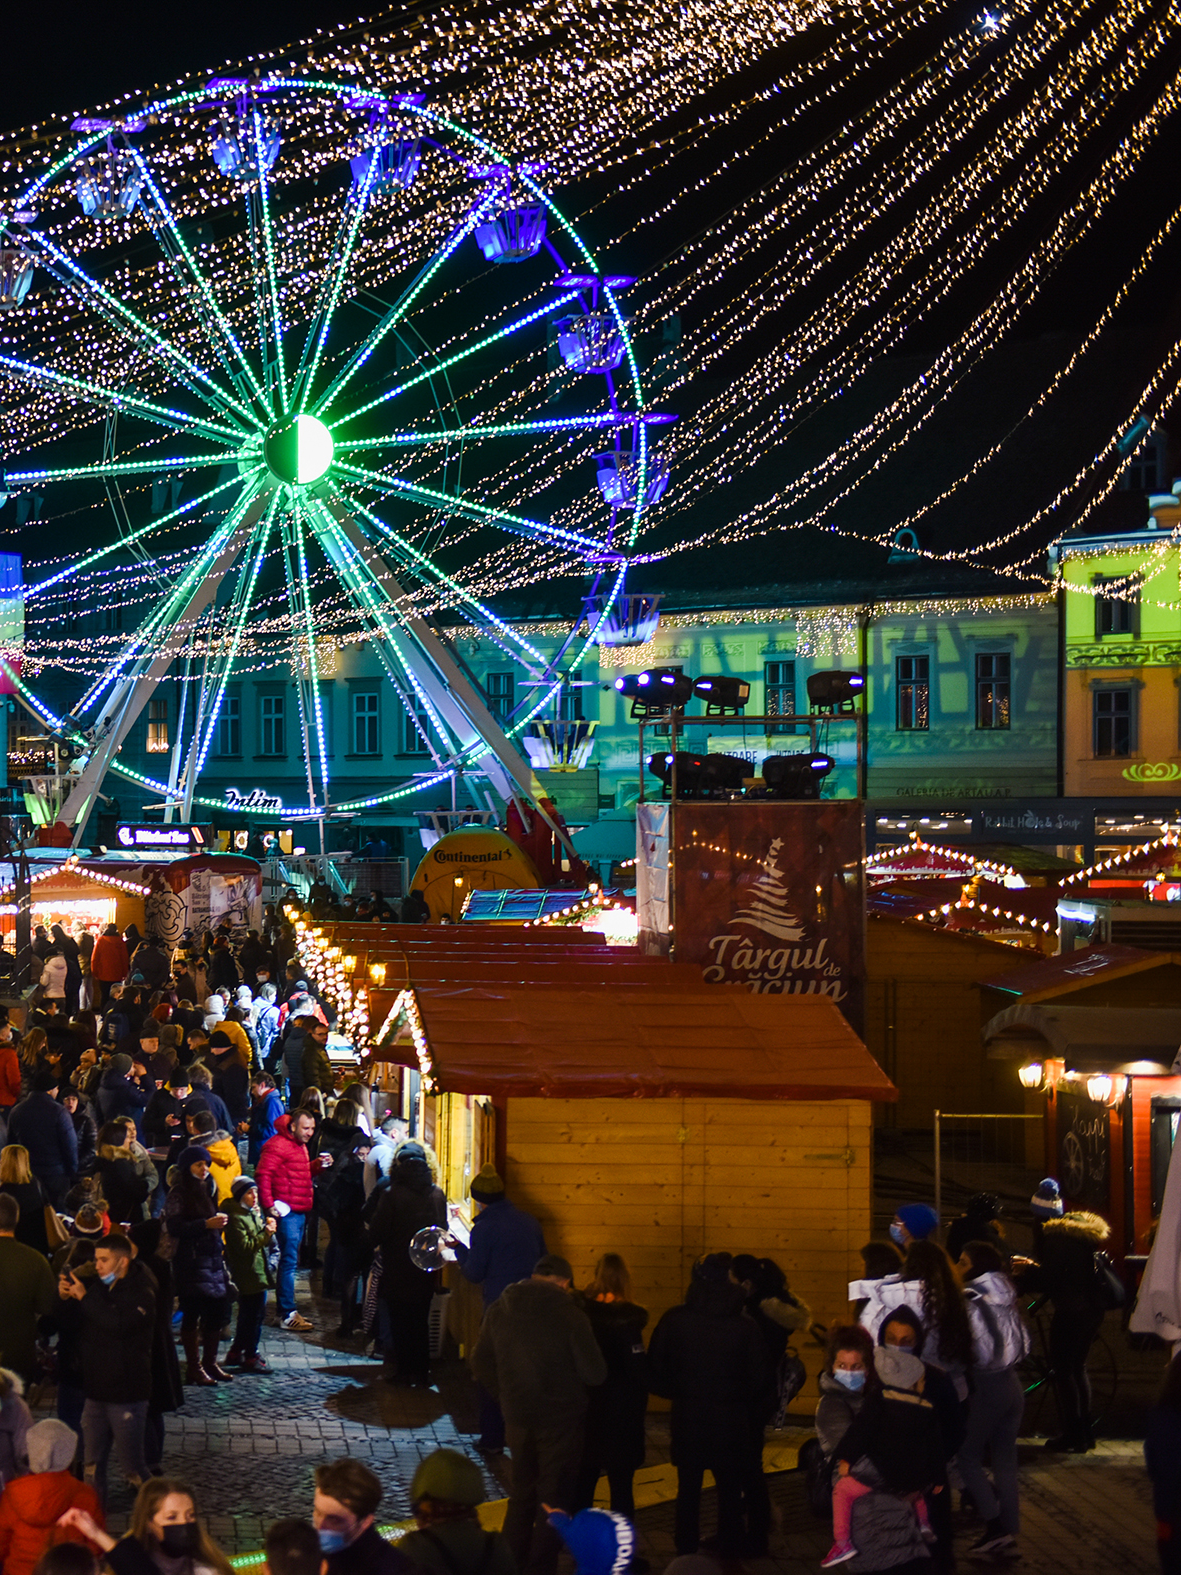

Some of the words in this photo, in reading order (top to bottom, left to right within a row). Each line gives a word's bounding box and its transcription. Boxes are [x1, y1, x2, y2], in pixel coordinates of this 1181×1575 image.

[224, 790, 280, 808] Intim
[941, 787, 956, 798] DE
[985, 816, 1016, 829] Rabbit
[1055, 814, 1081, 831] Soup
[433, 849, 503, 864] Continental
[708, 934, 830, 980] Târgul
[822, 962, 841, 977] de
[702, 964, 848, 1003] Căciun
